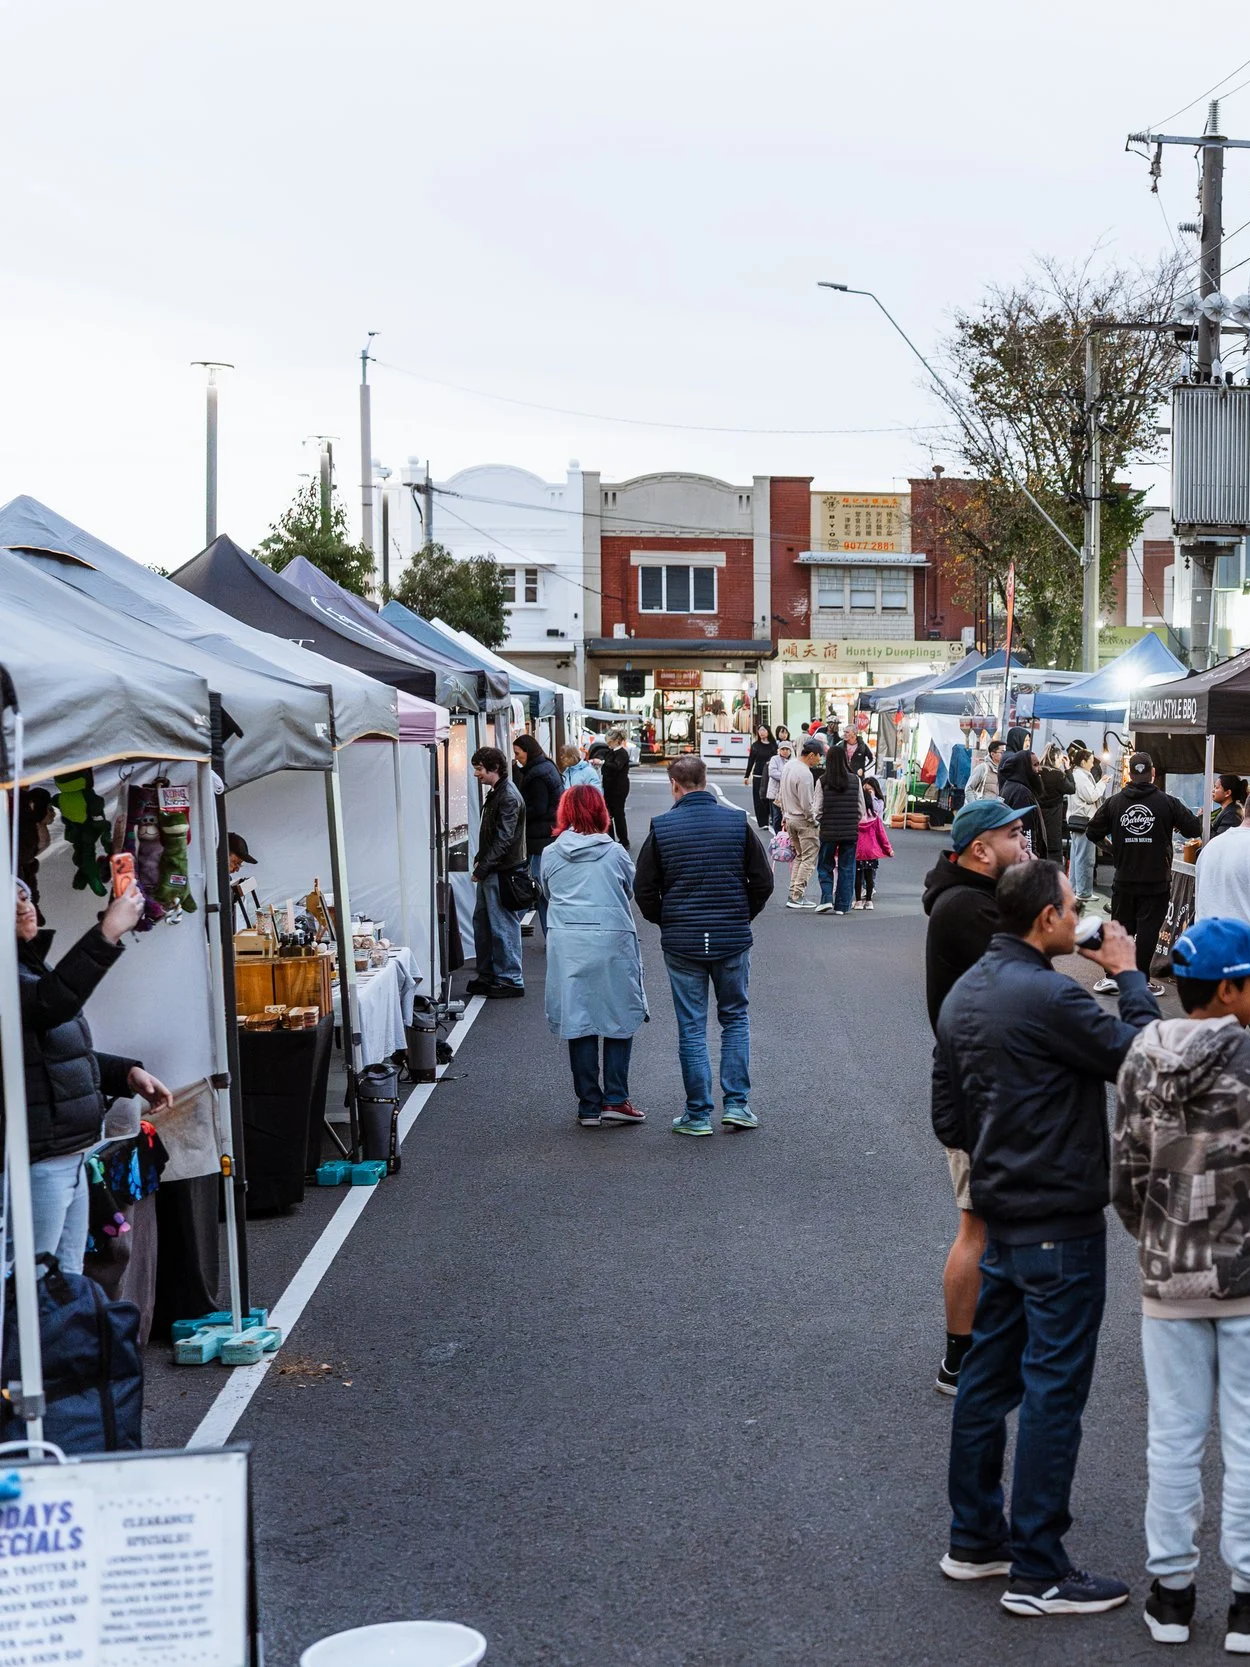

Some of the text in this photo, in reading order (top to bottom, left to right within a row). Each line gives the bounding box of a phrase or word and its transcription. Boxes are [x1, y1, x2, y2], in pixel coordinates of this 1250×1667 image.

[844, 542, 895, 550] 9077 2881
[845, 646, 942, 661] Huntly Dumplings
[1163, 698, 1182, 719] STYLE
[1183, 697, 1197, 724] BBQ
